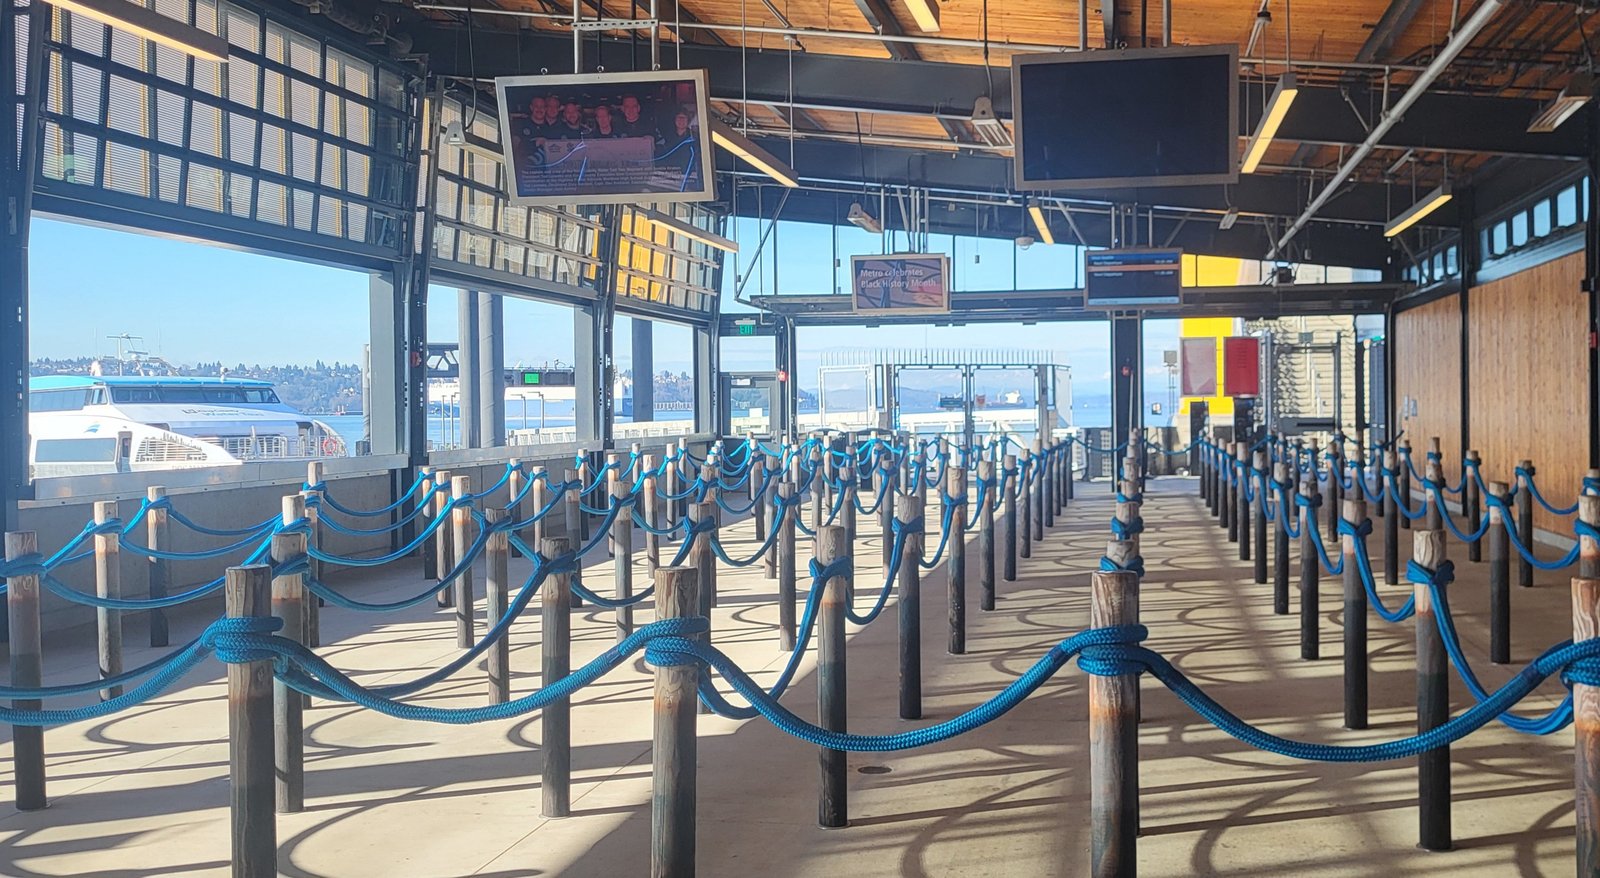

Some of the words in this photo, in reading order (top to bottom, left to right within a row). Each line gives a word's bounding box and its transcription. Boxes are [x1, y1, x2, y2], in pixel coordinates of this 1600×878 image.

[860, 269, 883, 277] Metro
[884, 268, 923, 277] celebrates
[861, 279, 881, 288] Black
[882, 278, 910, 288] History
[739, 324, 753, 335] EXIT
